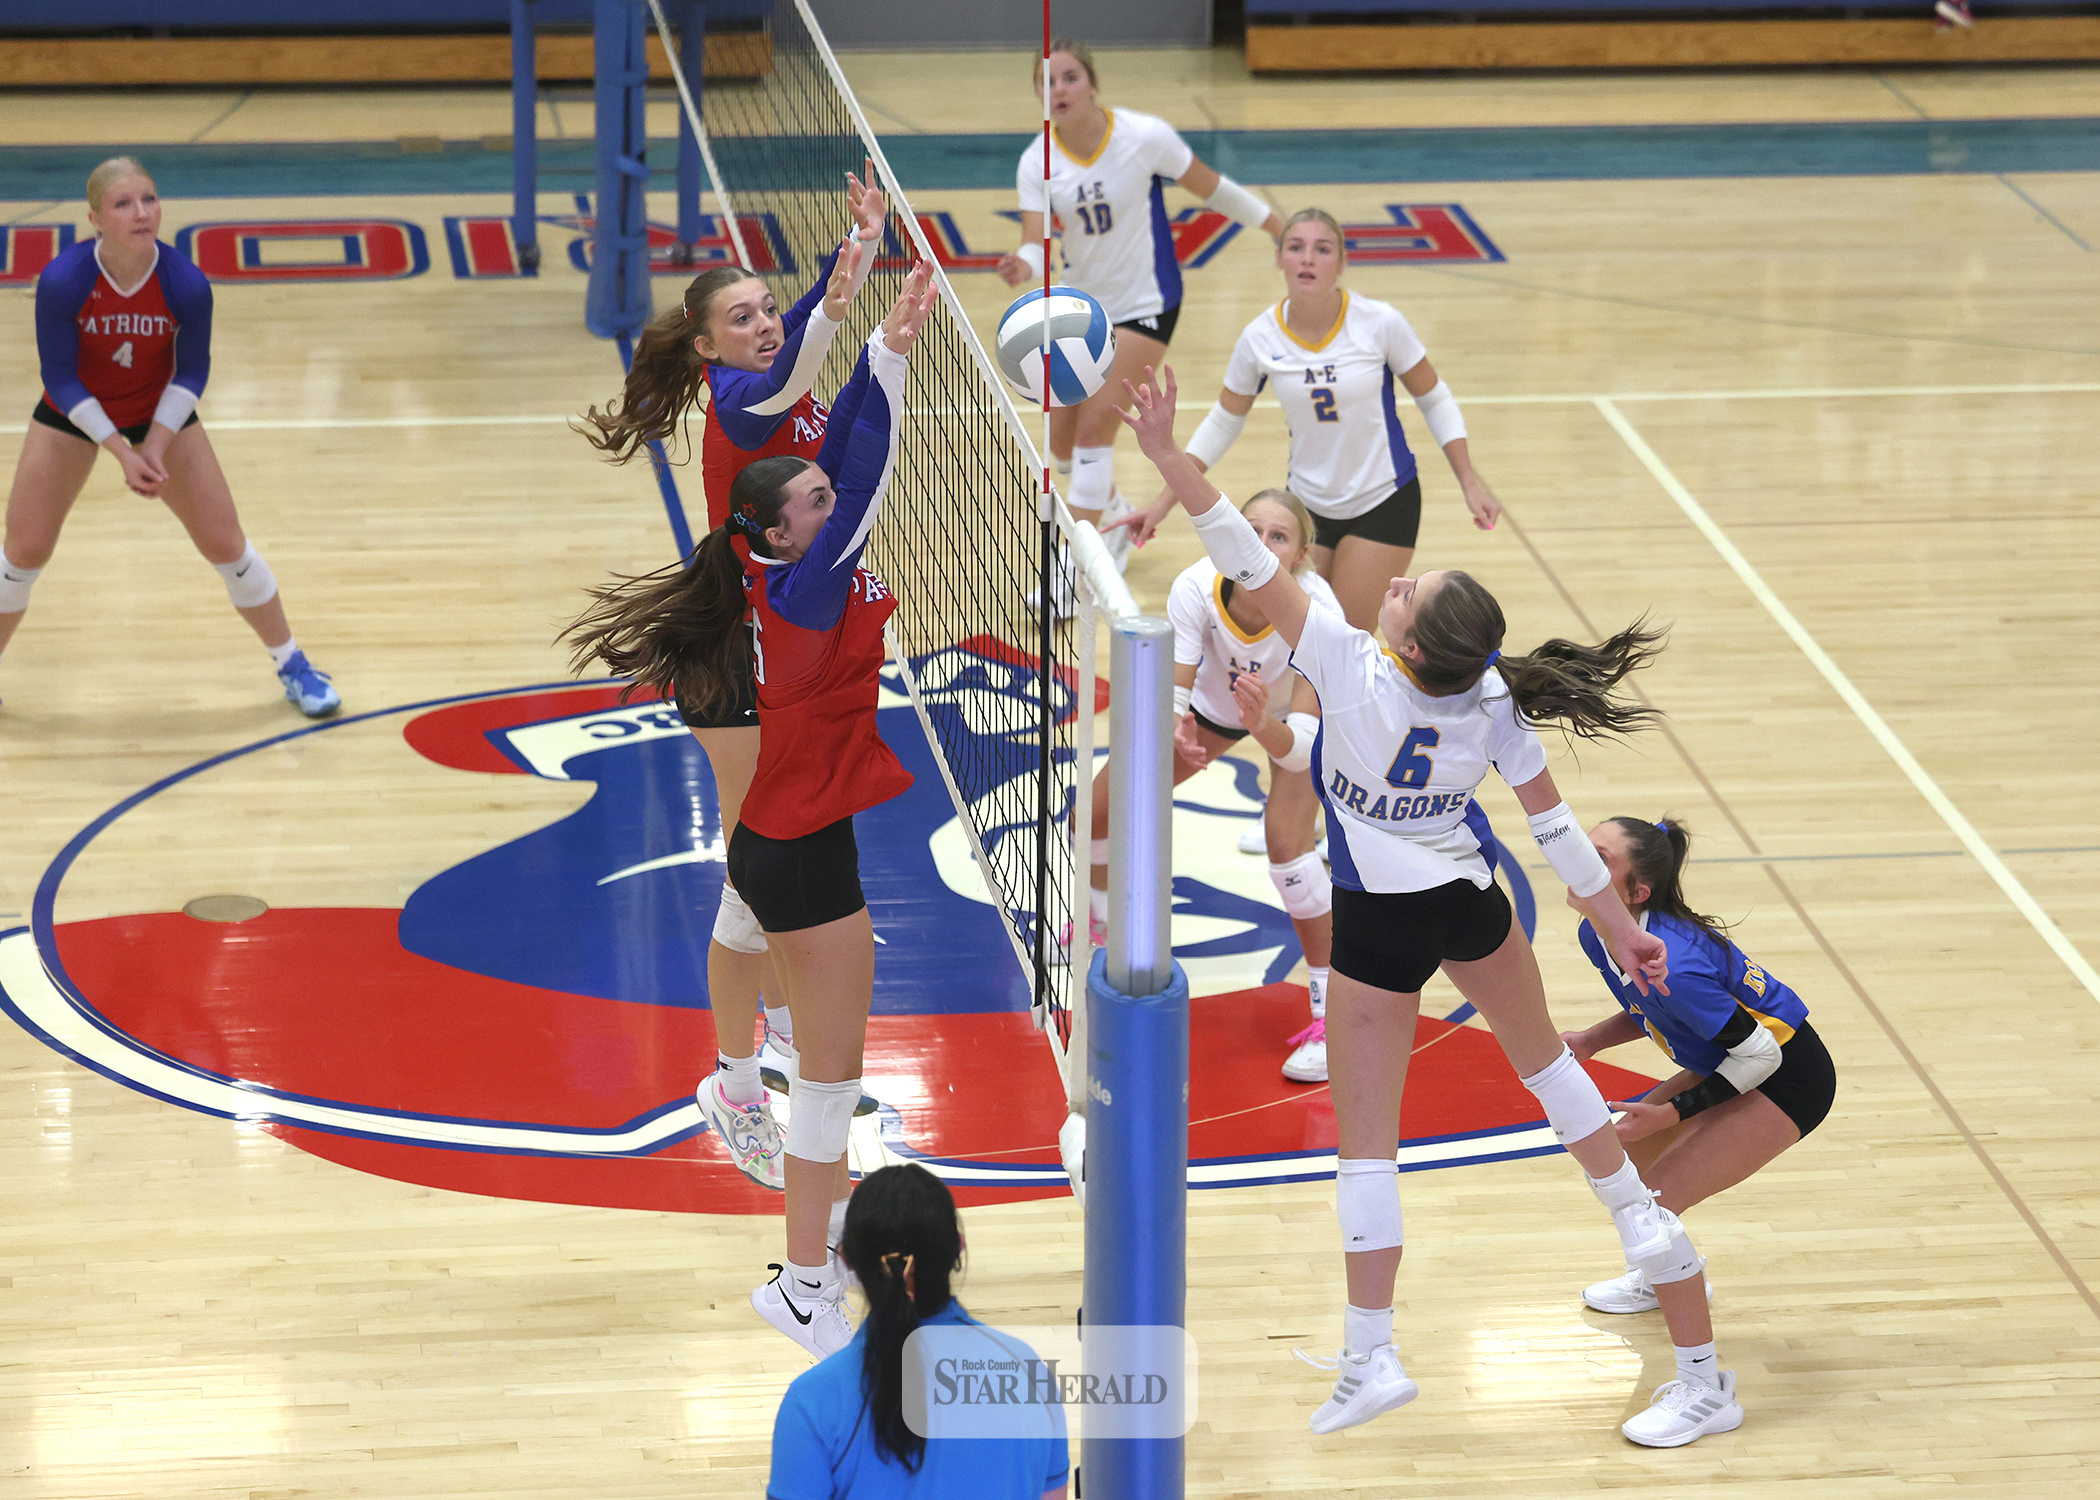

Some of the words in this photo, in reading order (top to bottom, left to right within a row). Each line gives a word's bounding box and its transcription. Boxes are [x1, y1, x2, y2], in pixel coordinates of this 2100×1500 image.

[1076, 182, 1104, 203] A-E
[1076, 203, 1114, 236] 10
[78, 313, 180, 337] ATRIOT
[111, 340, 134, 370] 4
[1304, 364, 1337, 384] A-E
[1310, 387, 1340, 423] 2
[1384, 725, 1442, 791] 6
[1329, 768, 1467, 822] DRAGONS
